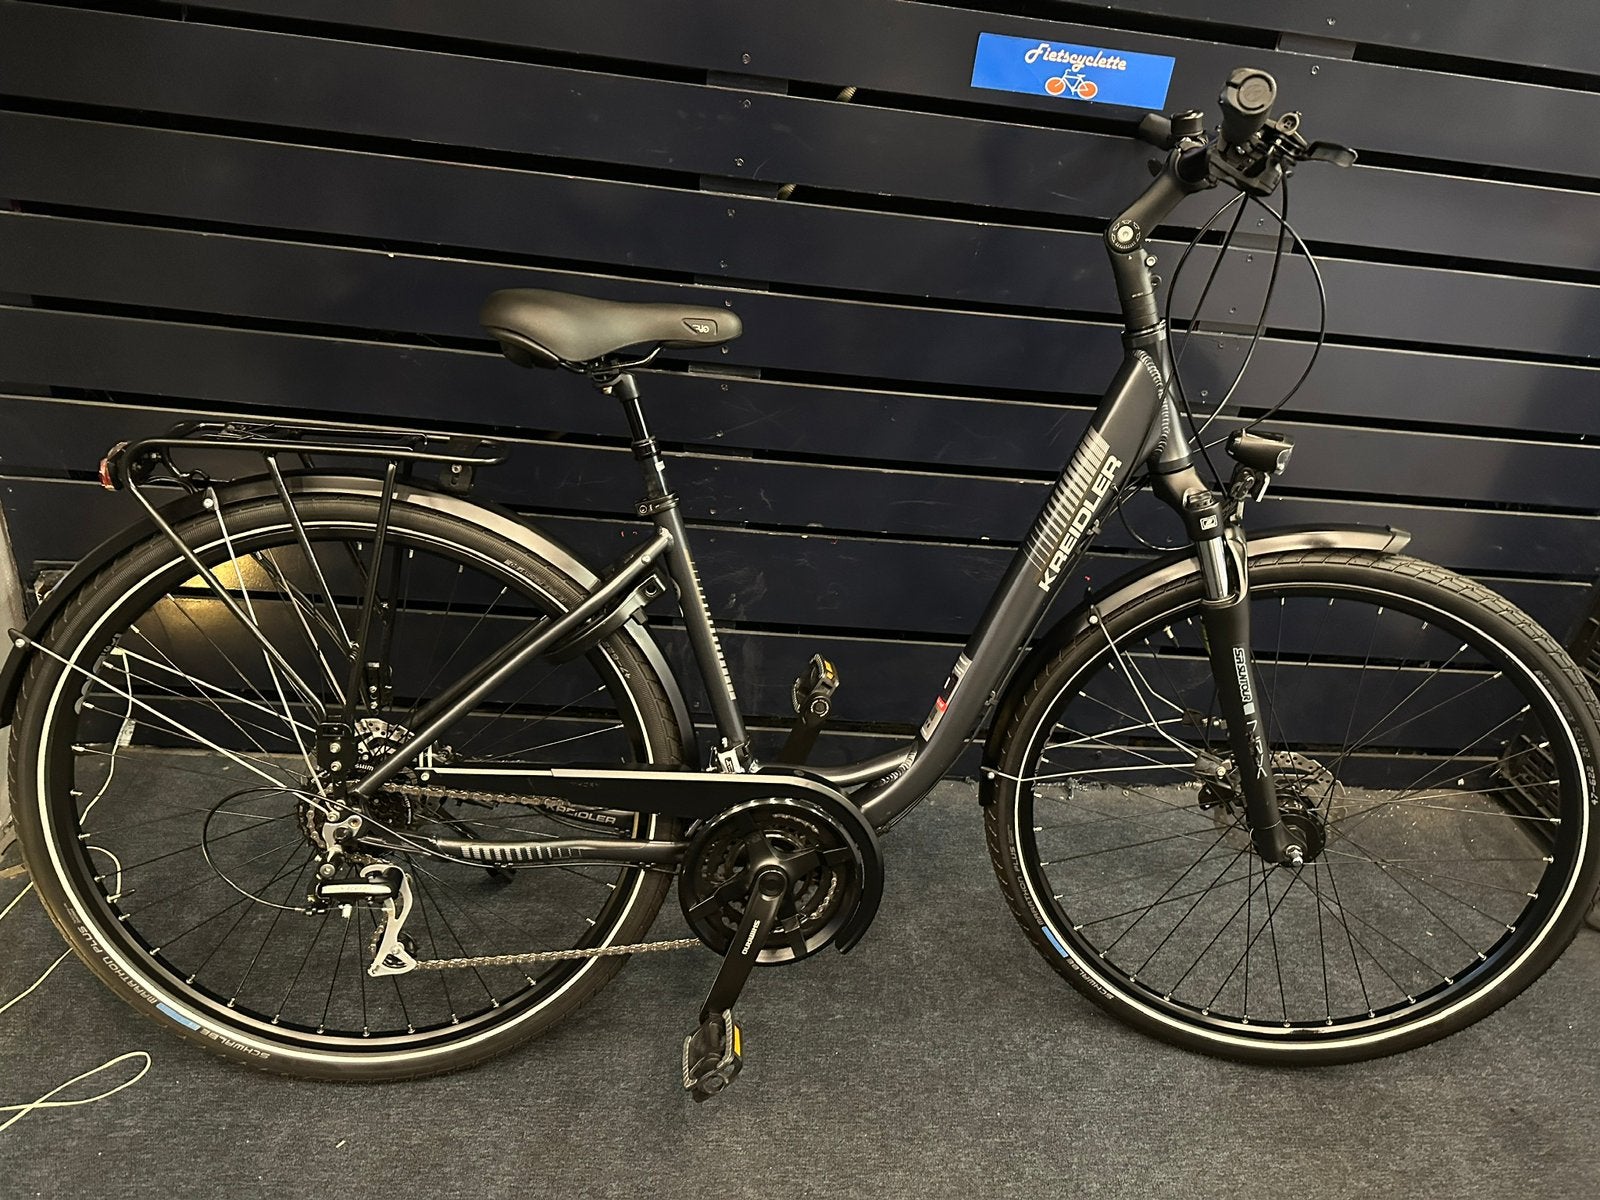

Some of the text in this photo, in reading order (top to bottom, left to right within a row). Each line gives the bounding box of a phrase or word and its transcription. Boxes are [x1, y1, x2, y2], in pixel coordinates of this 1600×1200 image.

[1024, 43, 1127, 72] Fietscyclette
[1038, 455, 1122, 592] KREIDLER
[1236, 664, 1253, 702] SUNTOUR
[1586, 765, 1598, 806] 47-622
[1009, 846, 1020, 872] PLUS
[741, 919, 760, 955] SHIMANO
[77, 925, 271, 1059] SCHWALBE MARATHON PLUS
